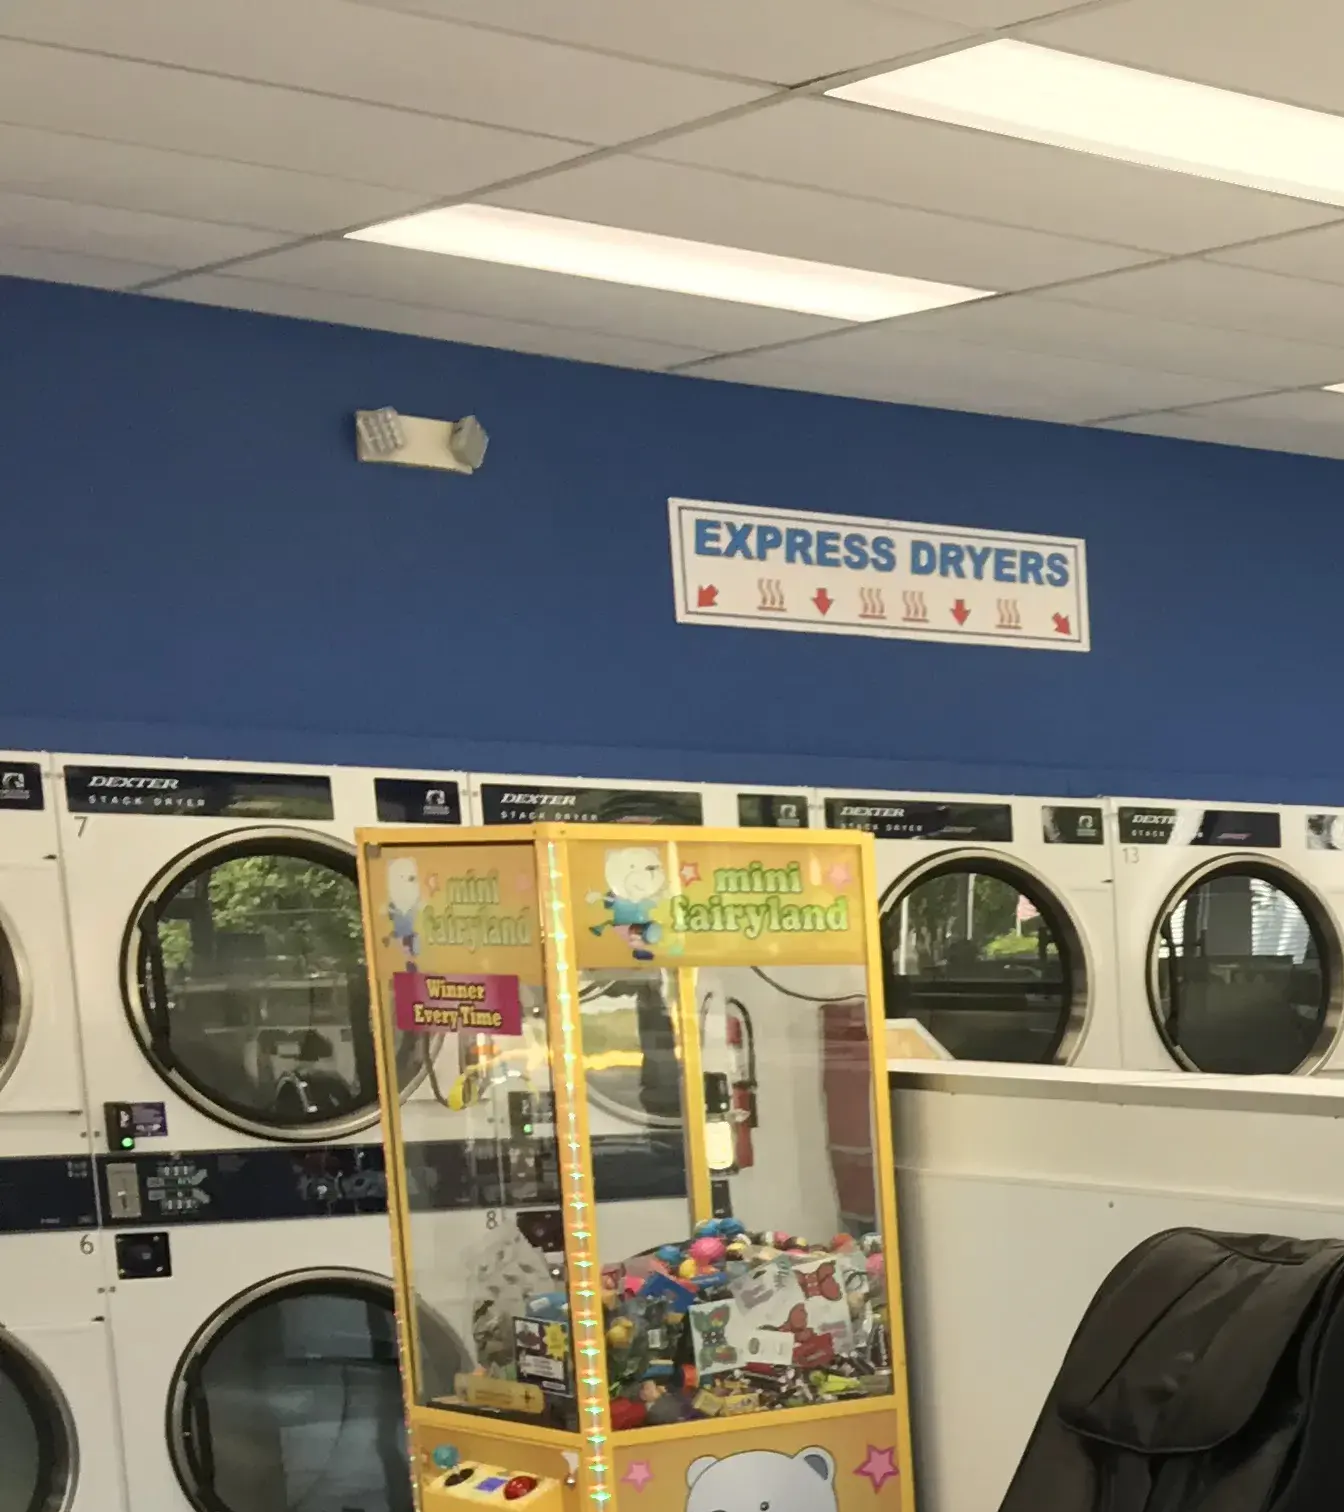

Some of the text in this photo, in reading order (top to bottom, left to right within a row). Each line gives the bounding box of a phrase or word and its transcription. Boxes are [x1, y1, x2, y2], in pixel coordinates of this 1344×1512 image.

[694, 519, 1070, 588] EXPRESS DRYERS
[88, 774, 180, 790] DEXTER
[500, 792, 577, 807] DEXTER
[840, 806, 906, 818] DEXTER
[73, 815, 88, 839] 7
[1121, 848, 1141, 864] 13
[712, 862, 803, 895] mini
[670, 895, 849, 938] fairyland
[425, 977, 486, 1002] Winner
[413, 1003, 502, 1030] Every Time
[484, 1211, 499, 1230] 8
[79, 1234, 95, 1255] 6
